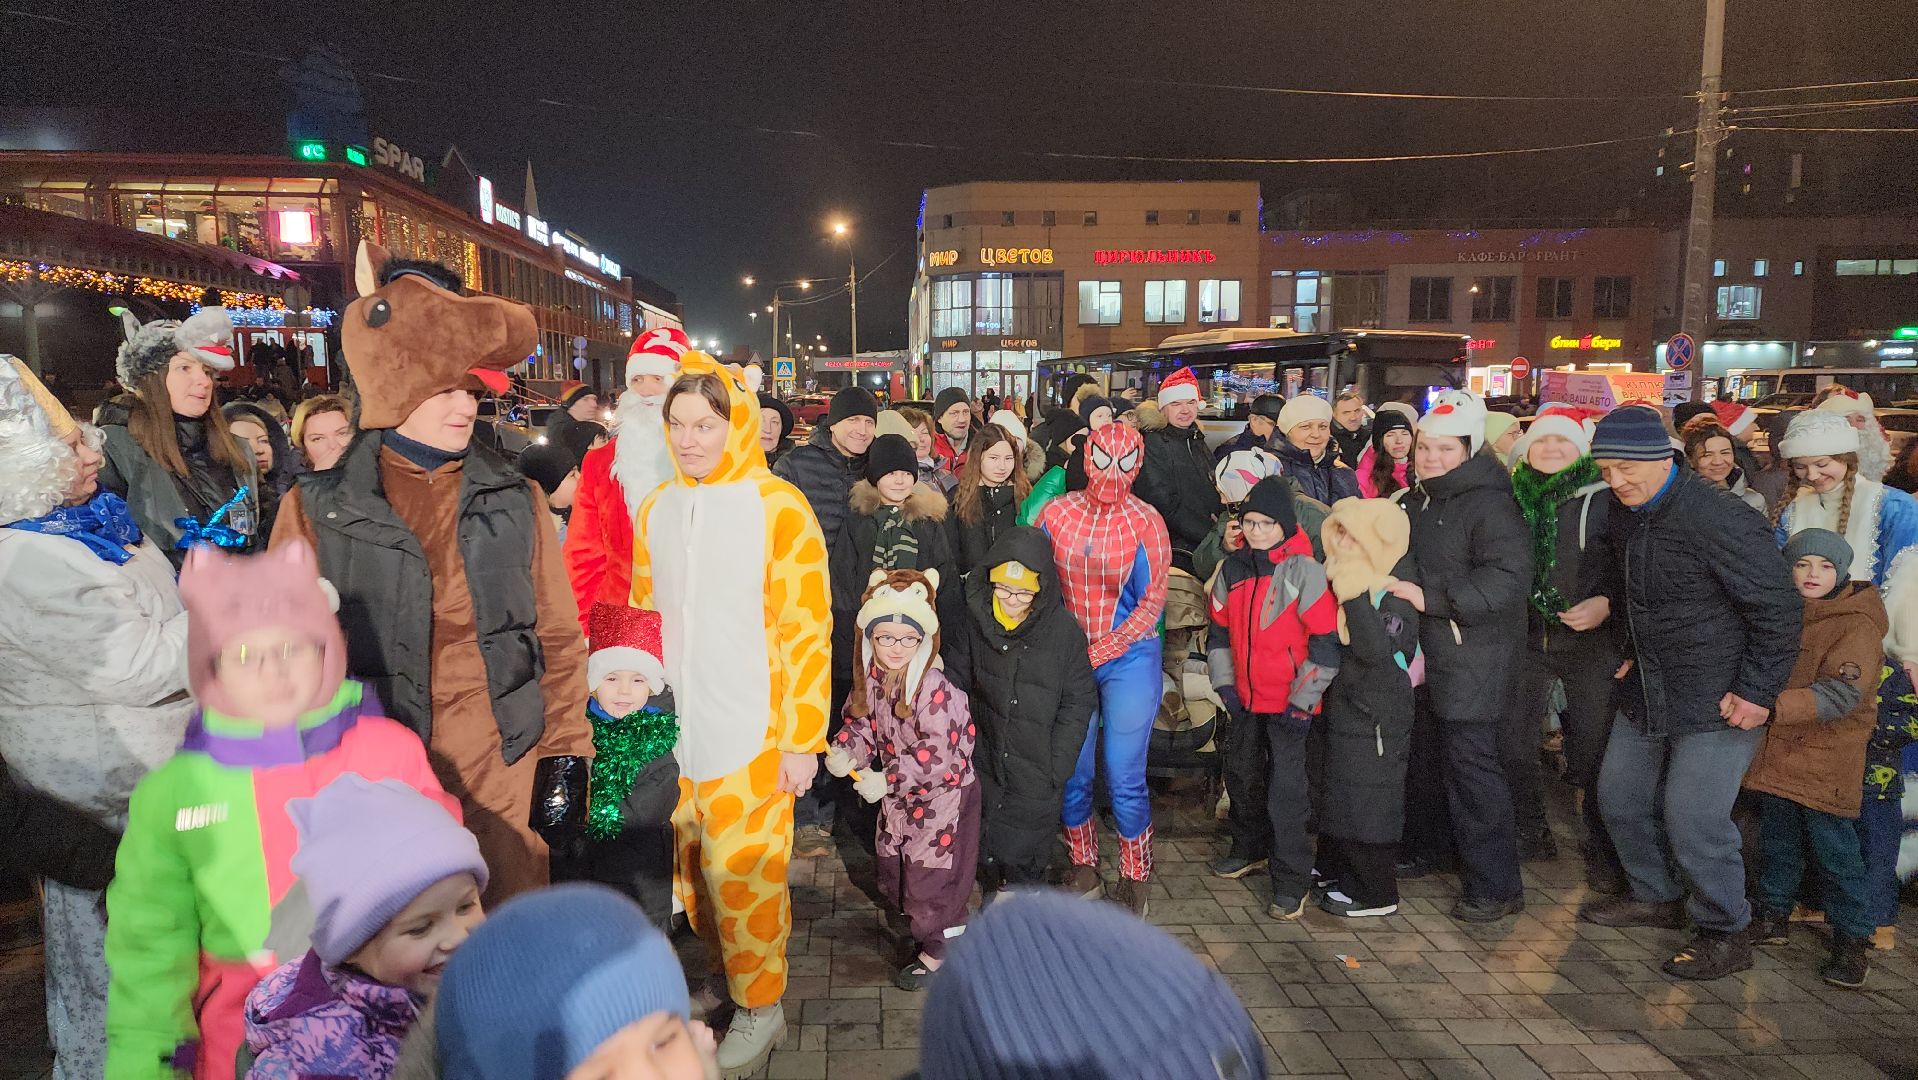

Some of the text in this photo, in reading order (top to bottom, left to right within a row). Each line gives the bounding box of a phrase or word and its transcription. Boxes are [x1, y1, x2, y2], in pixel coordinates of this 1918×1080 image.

[374, 137, 424, 182] SPAR
[929, 248, 1053, 267] МИР ЦВЕТОВ
[1094, 249, 1217, 265] ЦИРЮЛЬНИКЪ
[941, 339, 1037, 349] МИР ЦВЕТОВ
[1551, 335, 1621, 350] блин бери
[1569, 393, 1588, 404] ВАШ
[1589, 395, 1611, 407] АВТО
